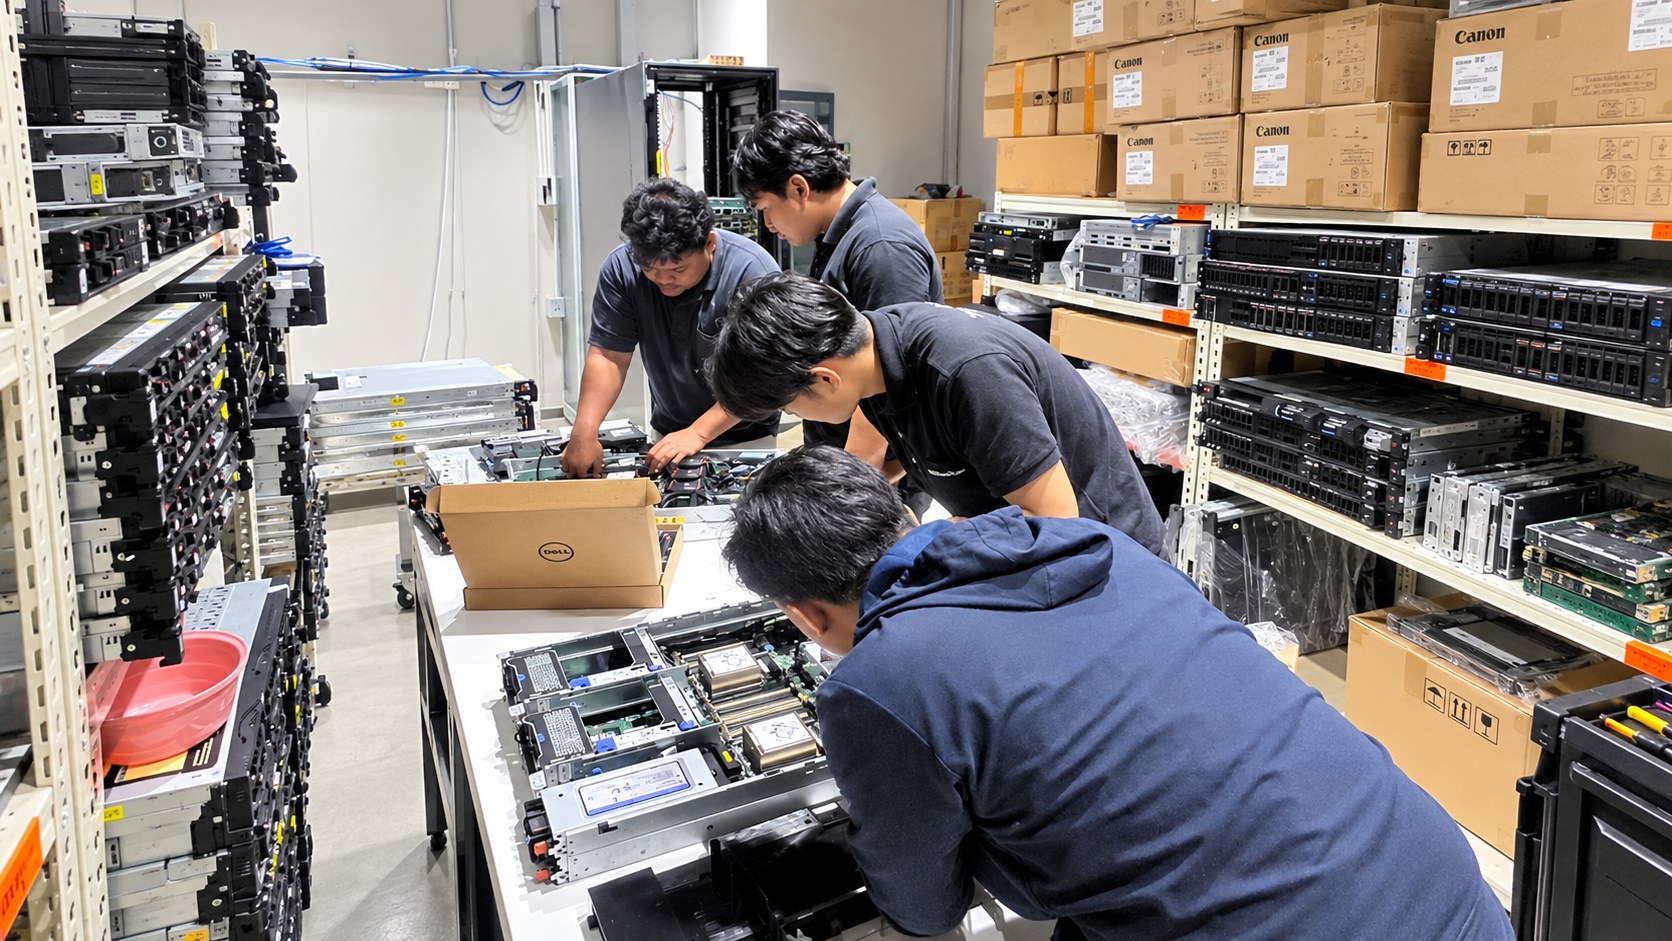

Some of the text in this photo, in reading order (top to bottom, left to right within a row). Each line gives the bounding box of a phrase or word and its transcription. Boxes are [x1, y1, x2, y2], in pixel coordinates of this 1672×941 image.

[1255, 32, 1289, 47] Canon
[1455, 27, 1506, 45] Canon
[1114, 57, 1143, 70] Canon
[1255, 125, 1290, 138] Canon
[1127, 137, 1154, 147] Canon
